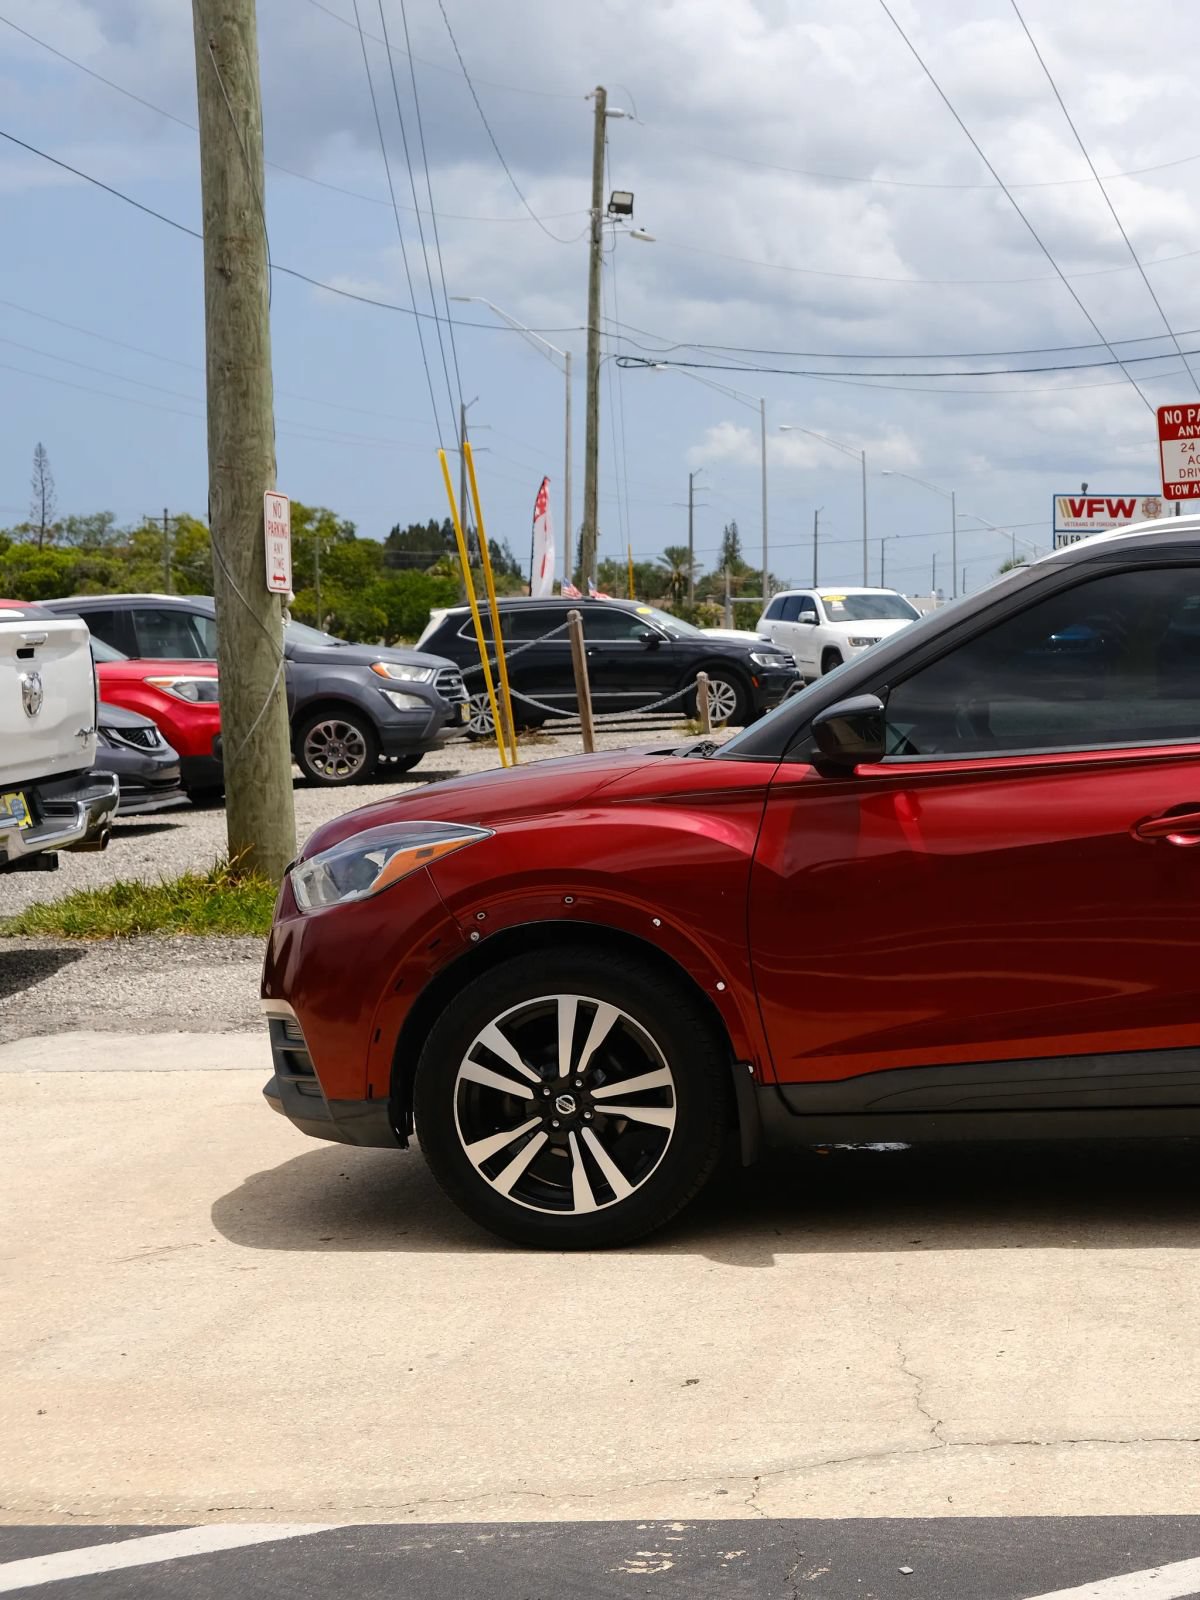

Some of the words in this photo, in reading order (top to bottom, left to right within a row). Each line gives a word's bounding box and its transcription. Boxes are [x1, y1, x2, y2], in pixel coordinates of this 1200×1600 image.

[1164, 410, 1182, 425] NO
[1180, 442, 1195, 453] 24
[1169, 484, 1190, 496] TOW
[272, 501, 282, 519] NO
[1068, 498, 1137, 519] VFW
[267, 520, 288, 539] PARKING
